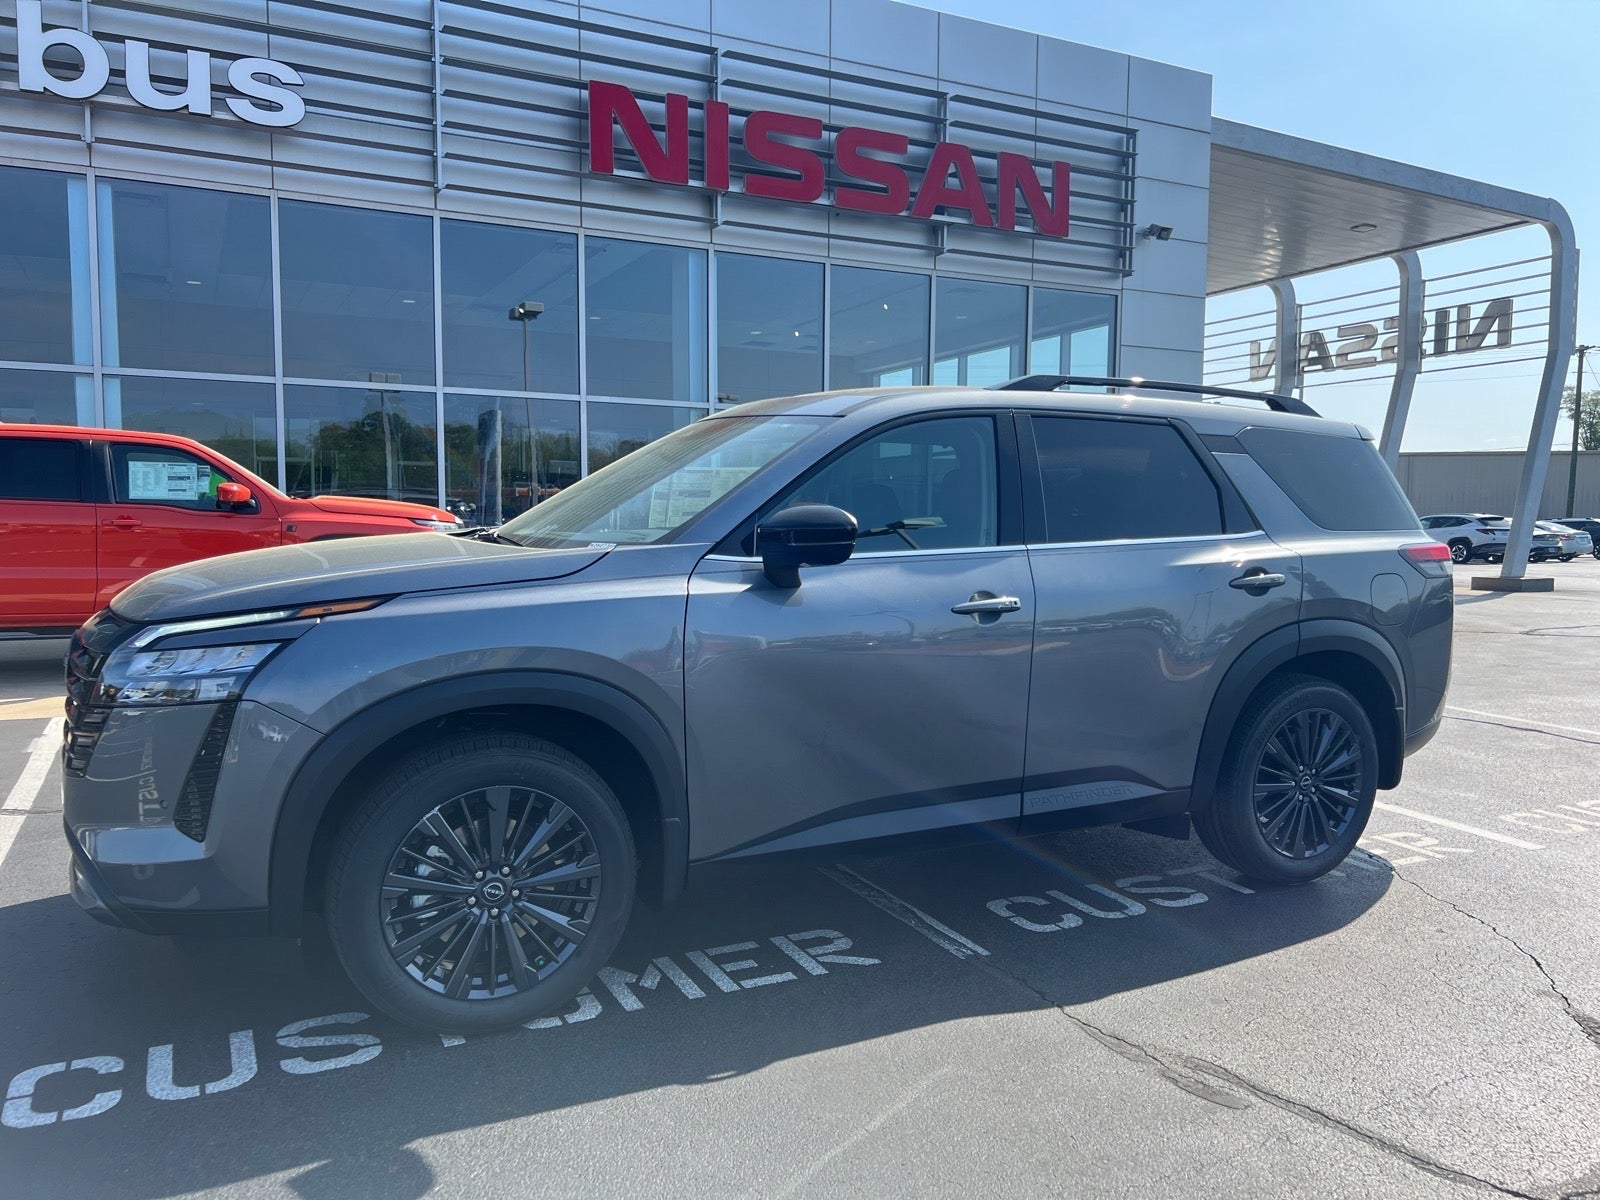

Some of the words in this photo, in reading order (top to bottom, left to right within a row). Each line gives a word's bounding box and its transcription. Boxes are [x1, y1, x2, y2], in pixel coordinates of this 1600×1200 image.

[588, 80, 1071, 237] NISSAN
[1029, 784, 1134, 808] PATHFINDER
[1, 928, 881, 1129] CUSMER
